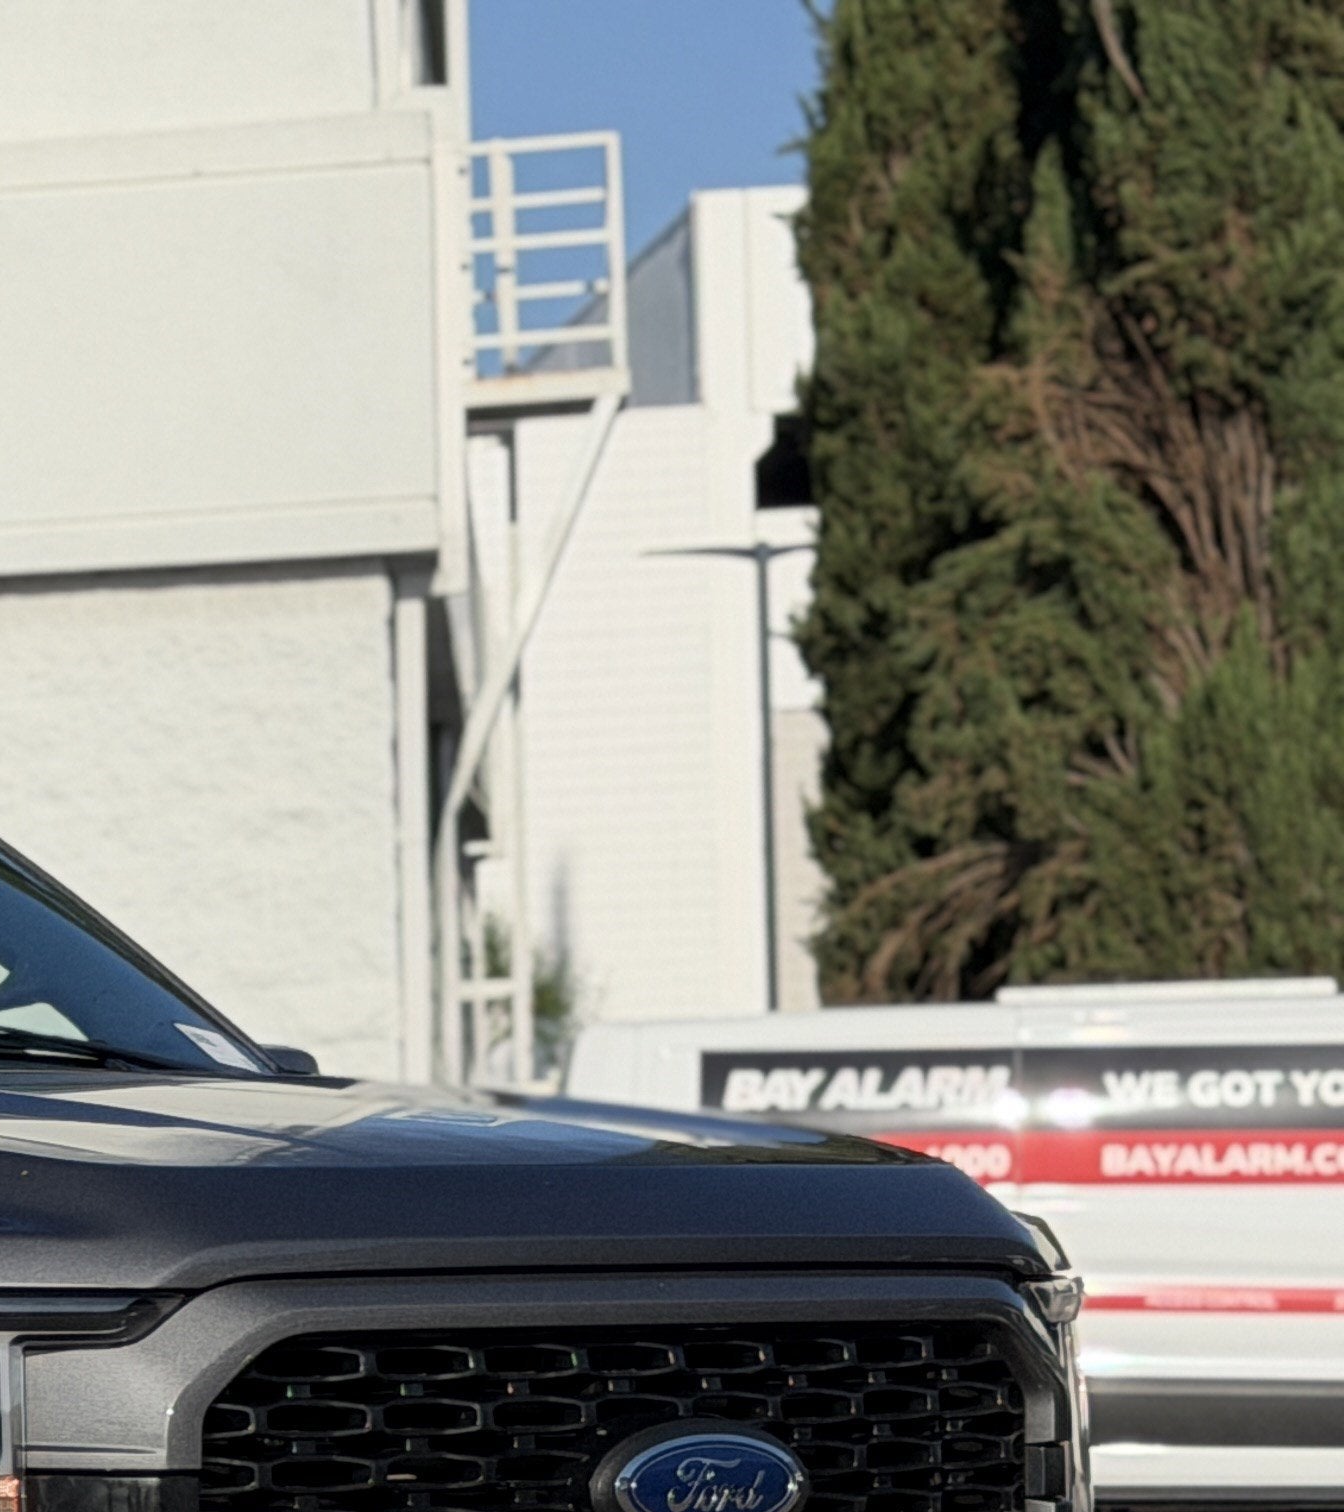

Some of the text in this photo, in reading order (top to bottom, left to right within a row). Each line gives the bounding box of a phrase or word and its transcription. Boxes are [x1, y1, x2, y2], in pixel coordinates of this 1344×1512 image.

[722, 1067, 826, 1111] BAY
[818, 1065, 1011, 1111] ALARM
[1102, 1071, 1180, 1109] WE
[1186, 1069, 1284, 1109] GOT
[1100, 1142, 1344, 1178] BAYALARM.C
